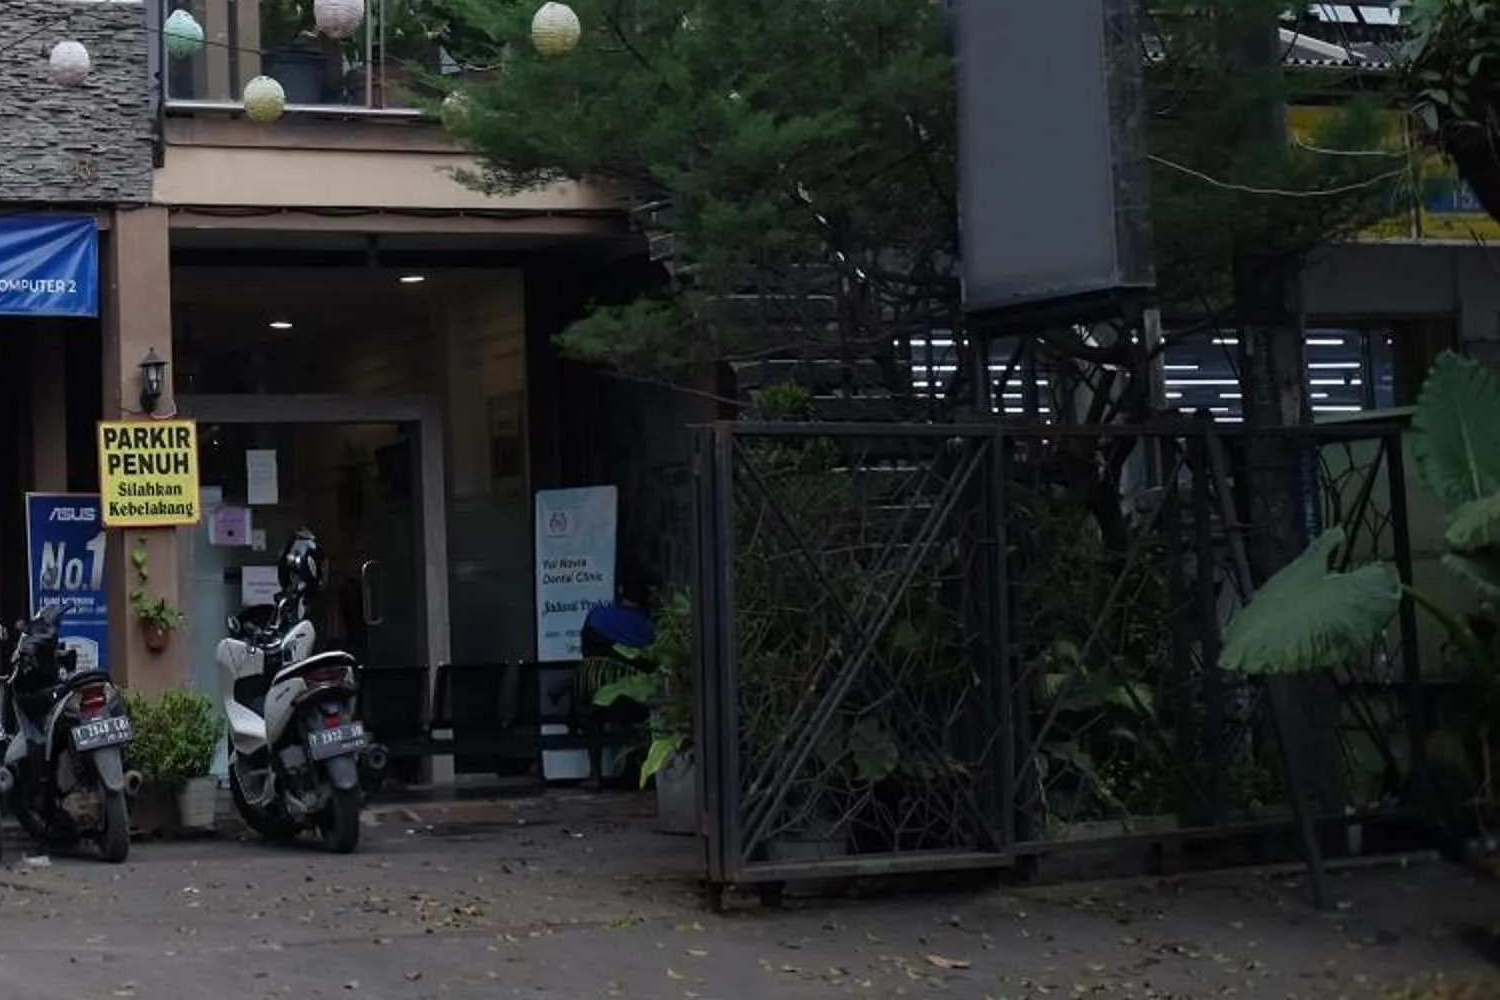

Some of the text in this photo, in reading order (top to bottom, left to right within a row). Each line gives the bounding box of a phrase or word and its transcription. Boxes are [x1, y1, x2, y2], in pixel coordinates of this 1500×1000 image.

[68, 279, 77, 293] 2
[103, 427, 191, 449] PARKIR
[107, 453, 189, 475] PENUH
[118, 482, 183, 496] Silahkan
[49, 507, 96, 521] ASUS
[109, 501, 194, 517] Kebelakang
[39, 530, 107, 591] No.1
